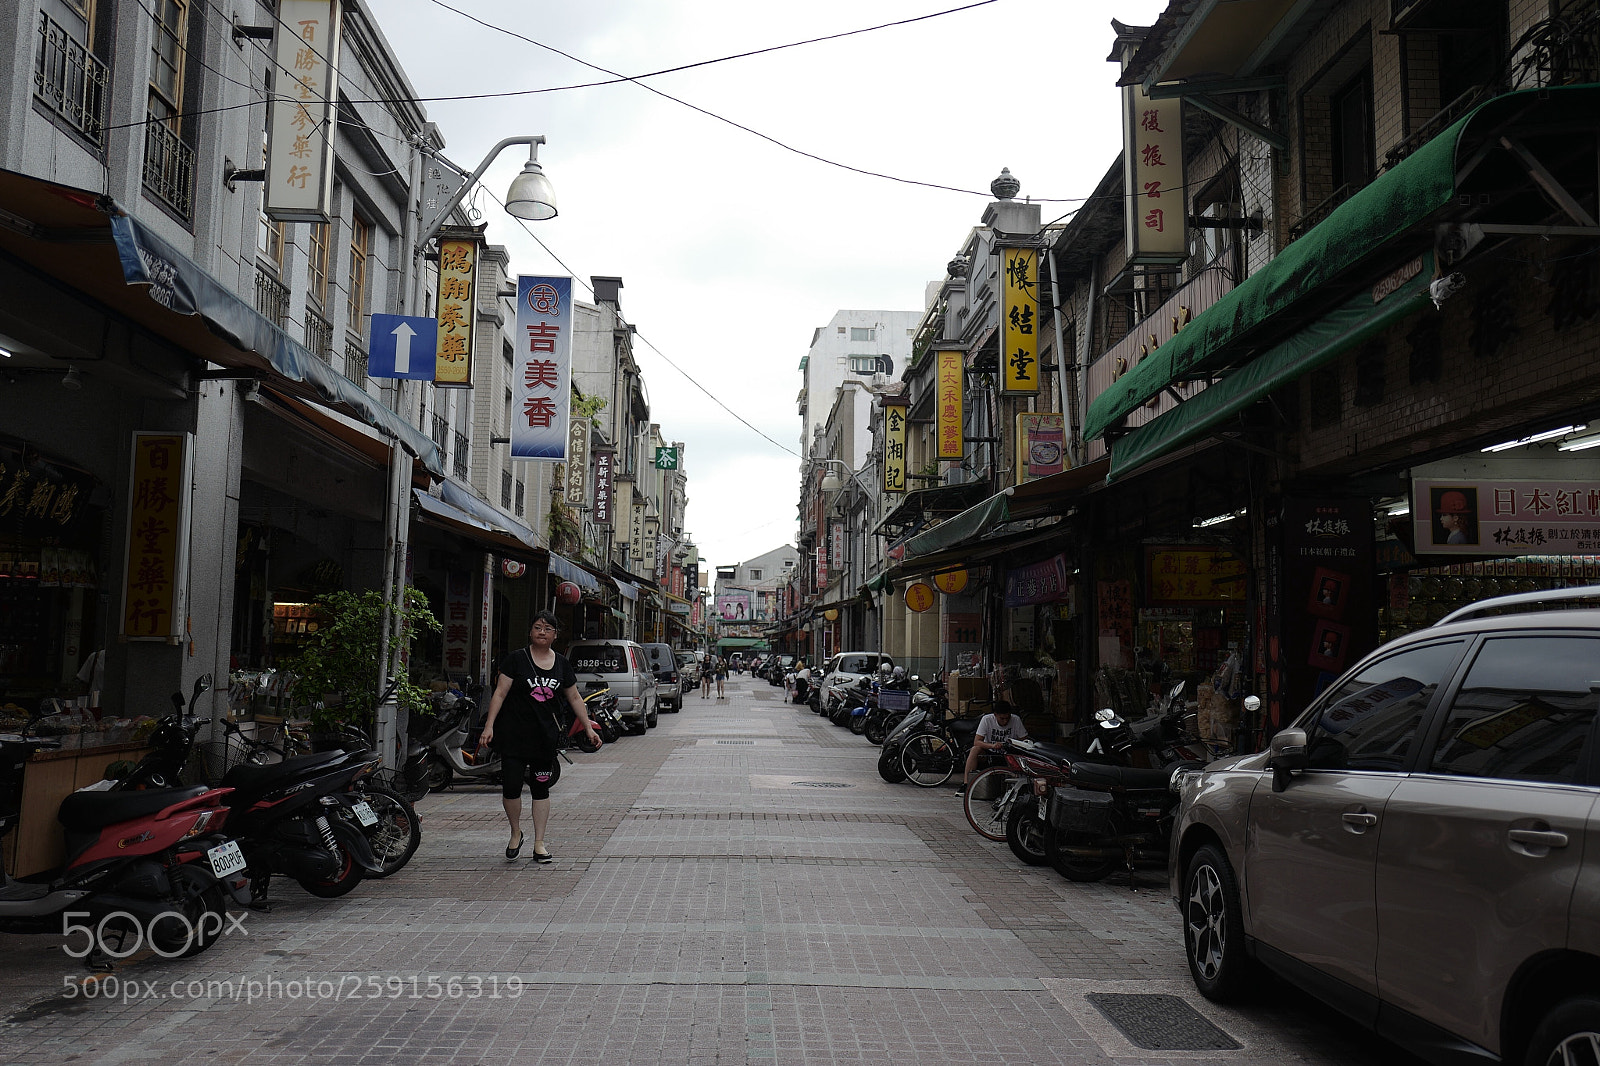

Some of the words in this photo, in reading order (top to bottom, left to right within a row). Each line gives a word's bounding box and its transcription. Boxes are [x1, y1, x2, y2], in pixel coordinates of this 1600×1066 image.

[1006, 258, 1035, 381] 懷結堂
[523, 321, 560, 428] 吉美香
[656, 448, 676, 468] 茶
[886, 408, 904, 489] 金湘記
[446, 601, 470, 668] 吉美香
